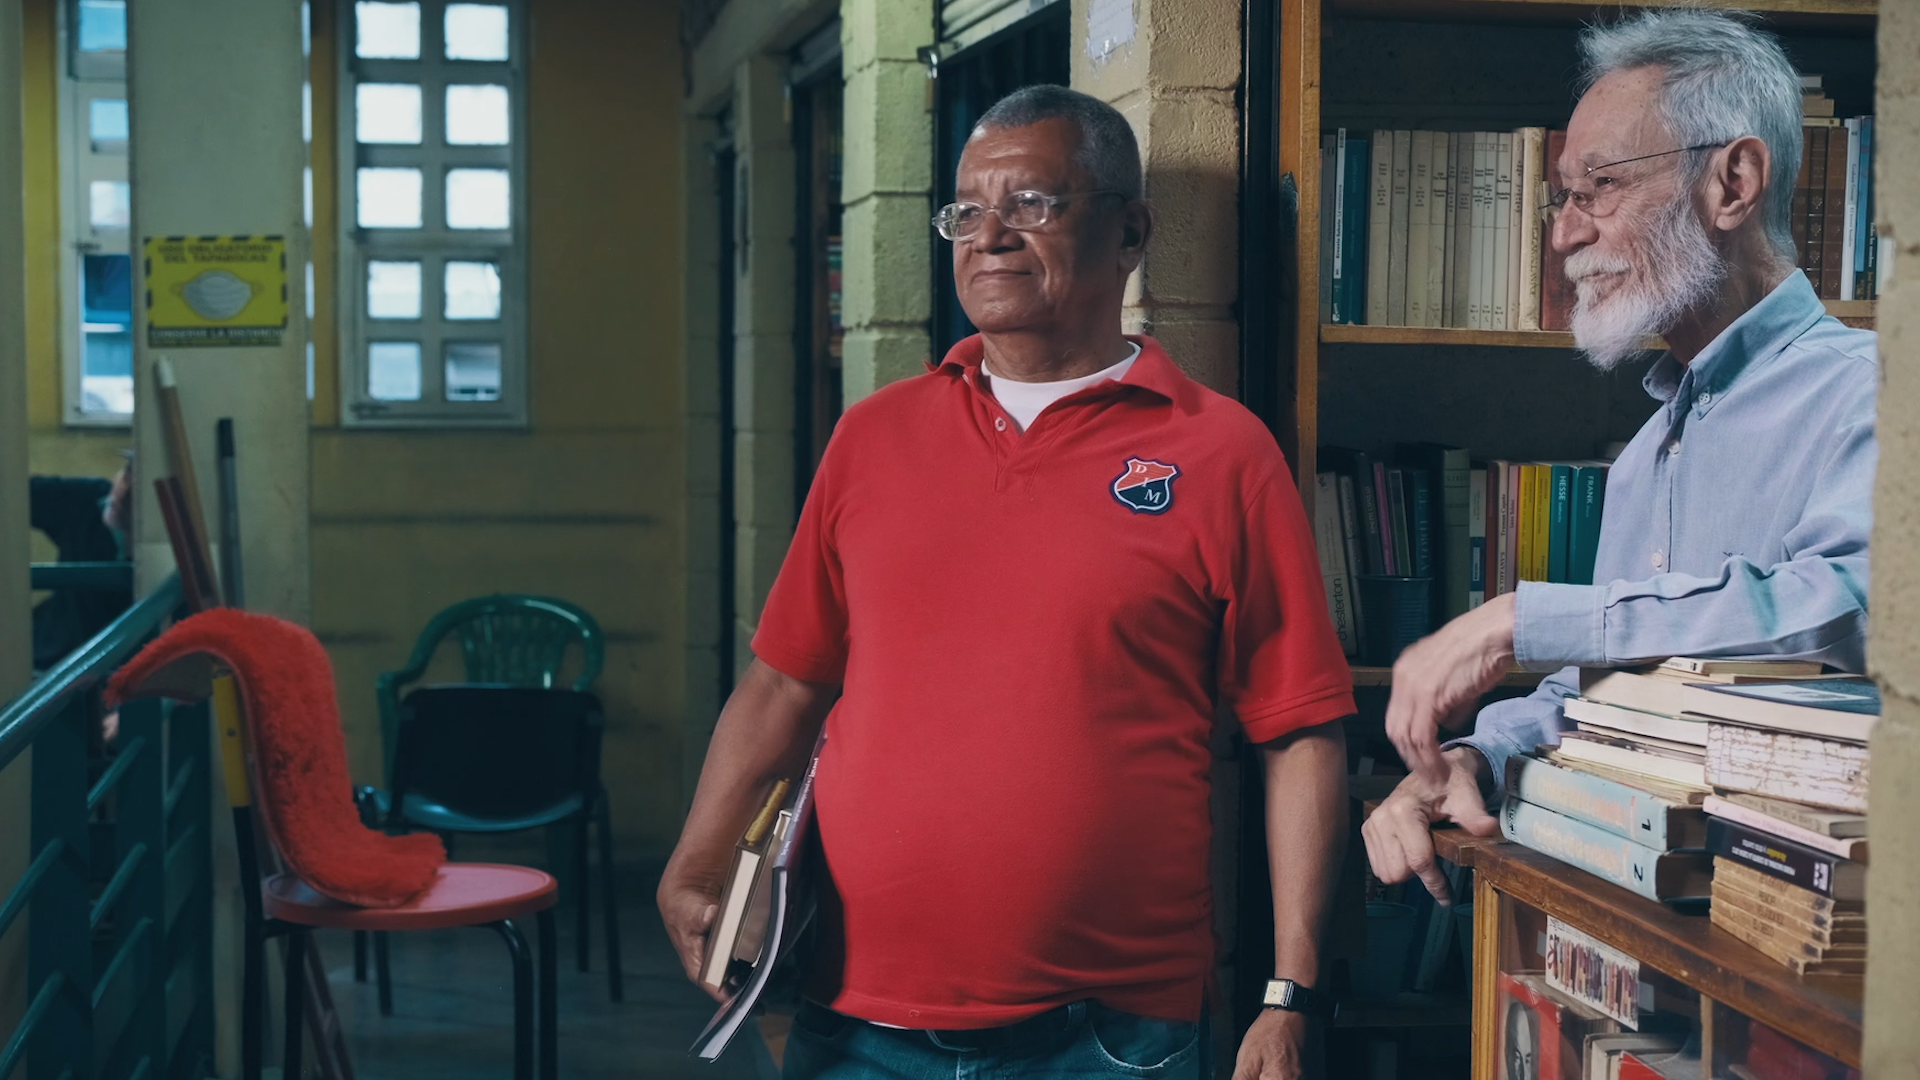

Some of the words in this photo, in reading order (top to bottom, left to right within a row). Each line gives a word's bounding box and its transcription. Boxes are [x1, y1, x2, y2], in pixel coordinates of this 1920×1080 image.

[1558, 475, 1566, 501] HESSE
[1586, 475, 1594, 504] FRANK
[1367, 511, 1376, 535] JOSEPH
[1333, 577, 1348, 641] chesterton
